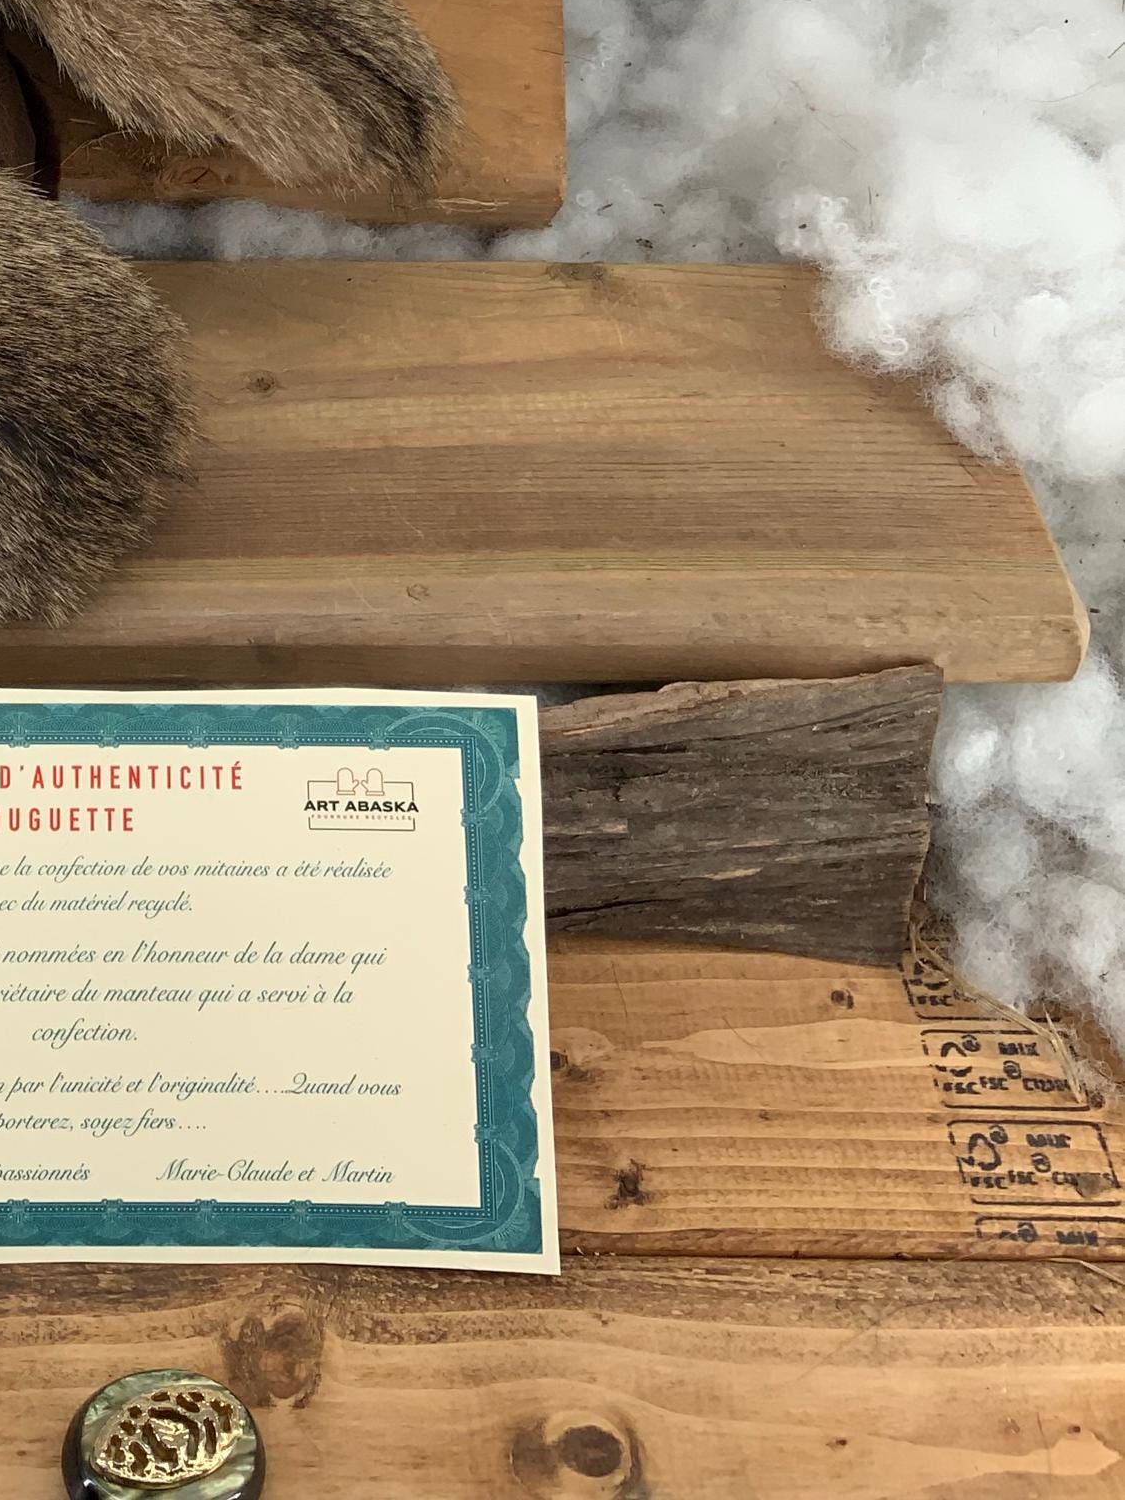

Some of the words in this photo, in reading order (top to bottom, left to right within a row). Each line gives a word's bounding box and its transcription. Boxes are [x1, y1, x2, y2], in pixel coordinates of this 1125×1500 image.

[0, 761, 242, 790] D'AUTHENTICITÉ
[304, 800, 339, 811] ART
[345, 800, 419, 812] ABASKA
[14, 855, 33, 876] la
[38, 855, 129, 883] confection
[132, 856, 155, 876] de
[158, 865, 189, 876] vos
[194, 860, 270, 877] mitaines
[276, 865, 288, 877] a
[294, 860, 322, 877] été
[323, 857, 391, 878] réalisée
[21, 890, 47, 911] du
[49, 890, 129, 911] matériel
[127, 890, 192, 919] recyclé.
[2, 944, 98, 963] nommées
[103, 950, 129, 963] en
[131, 940, 230, 963] l'honneur
[234, 941, 260, 964] de
[263, 941, 284, 964] la
[289, 941, 348, 965] dame
[351, 948, 387, 974] qui
[72, 979, 102, 1002] du
[103, 986, 196, 1002] manteau
[198, 989, 235, 1012] qui
[238, 990, 253, 1003] a
[257, 985, 310, 1003] servi
[313, 984, 328, 1004] à
[333, 980, 353, 1003] la
[32, 1017, 137, 1050] confection.
[4, 1077, 44, 1102] par
[49, 1072, 124, 1094] l'unicité
[126, 1079, 144, 1093] et
[357, 1083, 401, 1095] vous
[80, 1117, 133, 1138] soyez
[156, 1158, 296, 1181] Marie-Claude
[298, 1167, 316, 1182] et
[321, 1160, 393, 1183] Martin
